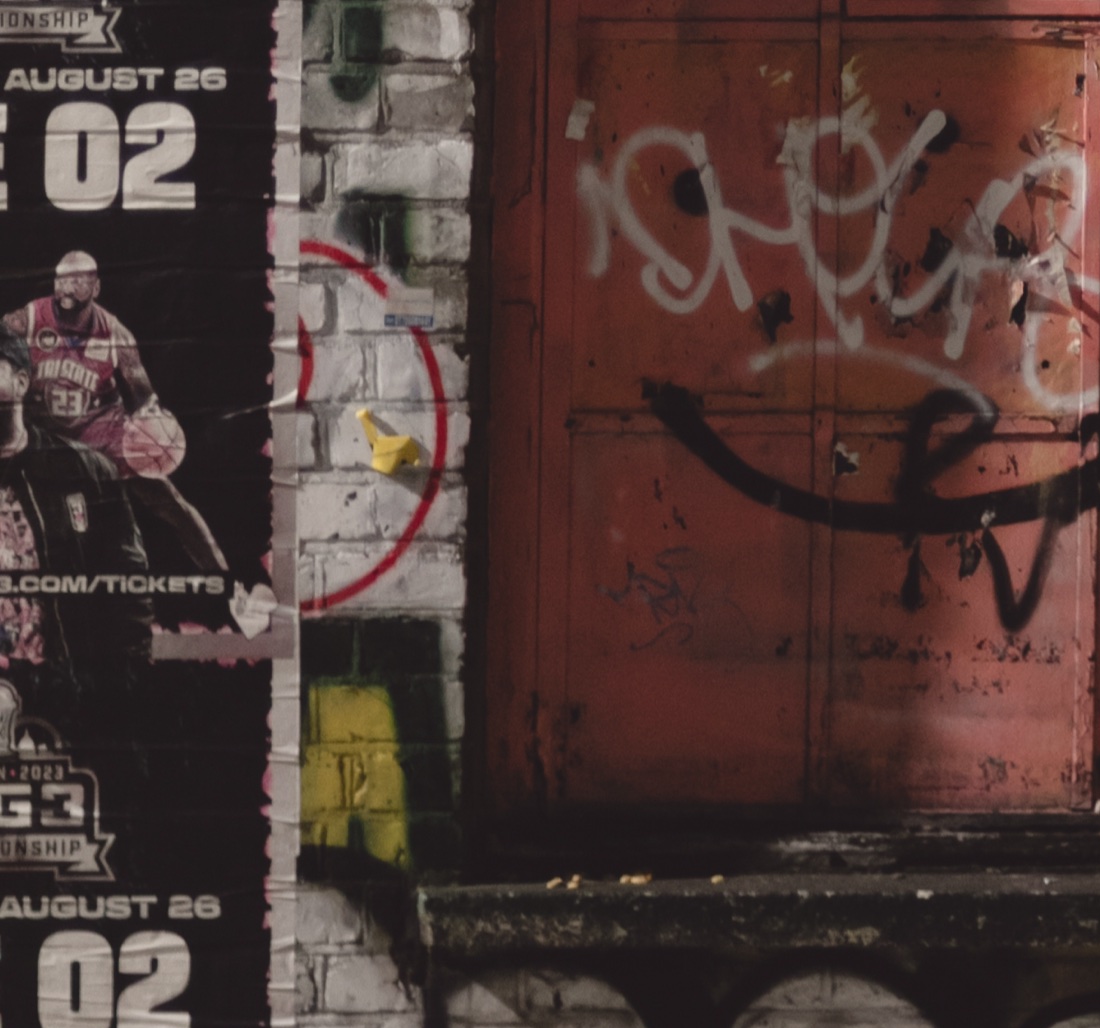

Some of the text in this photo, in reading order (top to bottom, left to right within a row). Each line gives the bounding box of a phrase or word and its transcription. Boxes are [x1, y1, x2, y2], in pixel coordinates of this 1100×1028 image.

[4, 67, 227, 91] AUGUST 26
[44, 101, 196, 211] 02
[0, 895, 221, 919] AUGUST 26
